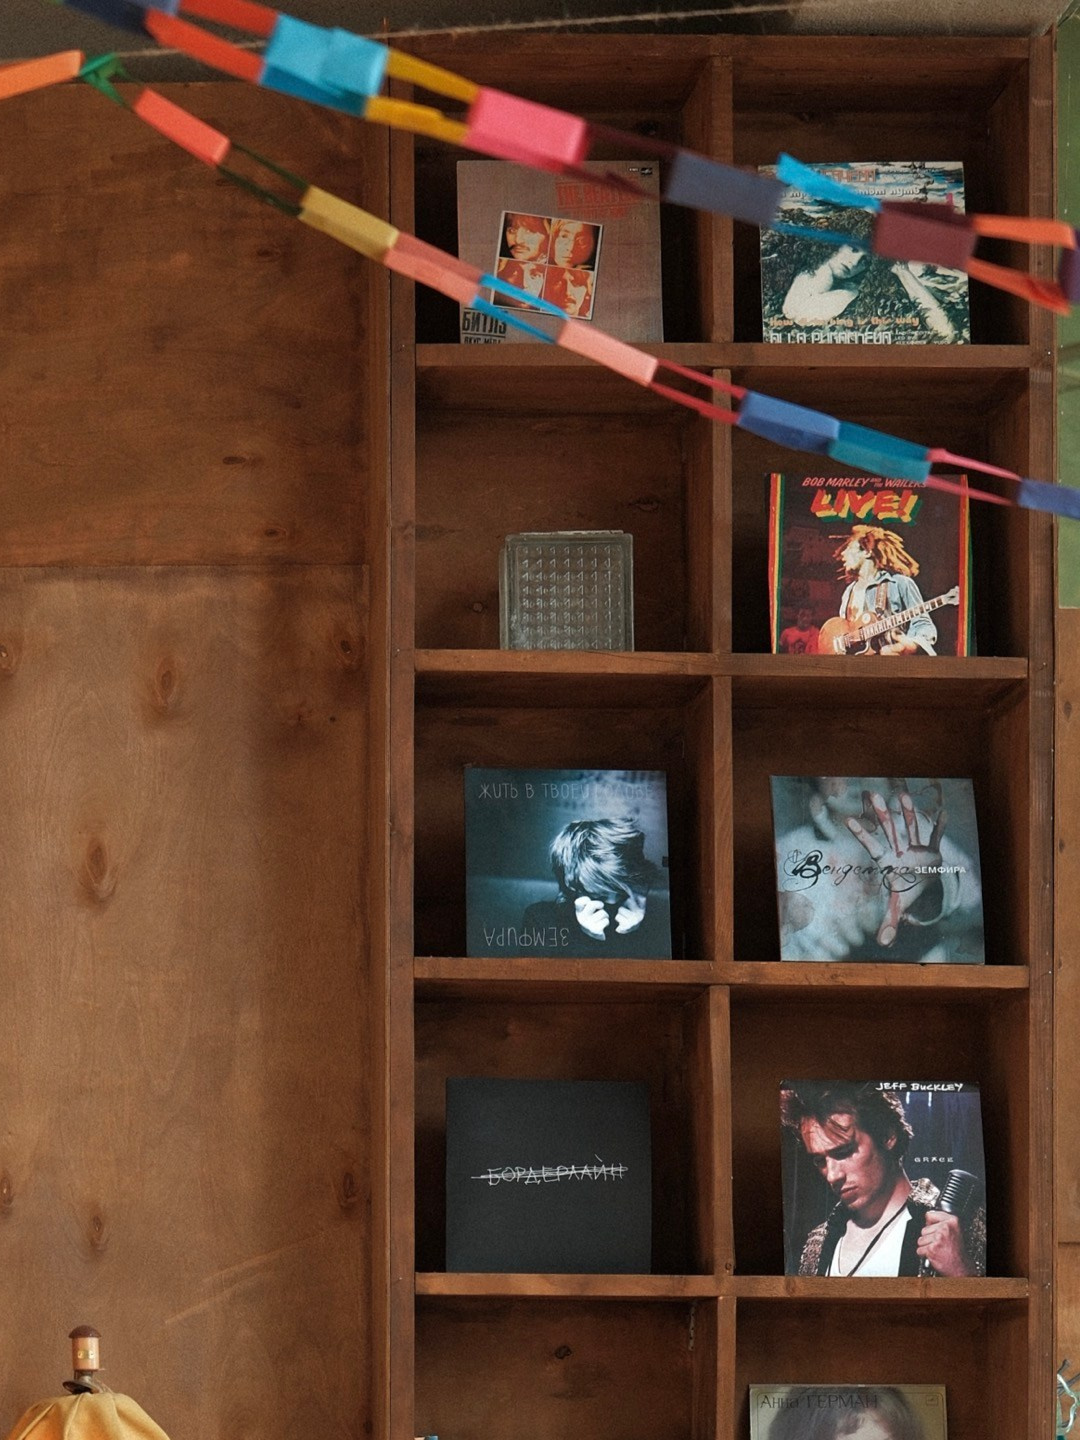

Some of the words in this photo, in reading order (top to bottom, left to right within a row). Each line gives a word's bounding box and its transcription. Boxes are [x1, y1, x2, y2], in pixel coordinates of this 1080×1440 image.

[896, 316, 920, 327] way
[802, 477, 824, 486] BOB
[824, 477, 870, 487] MARLEY
[810, 488, 922, 526] LIVE!
[525, 784, 534, 798] В
[914, 866, 966, 874] ЗЕМФИРА
[483, 927, 570, 947] ЗЕМФИРА
[875, 1082, 908, 1091] JEFF
[910, 1082, 964, 1092] BUCKLEY
[760, 1395, 799, 1409] Анна
[806, 1395, 878, 1408] ГЕРМАН
